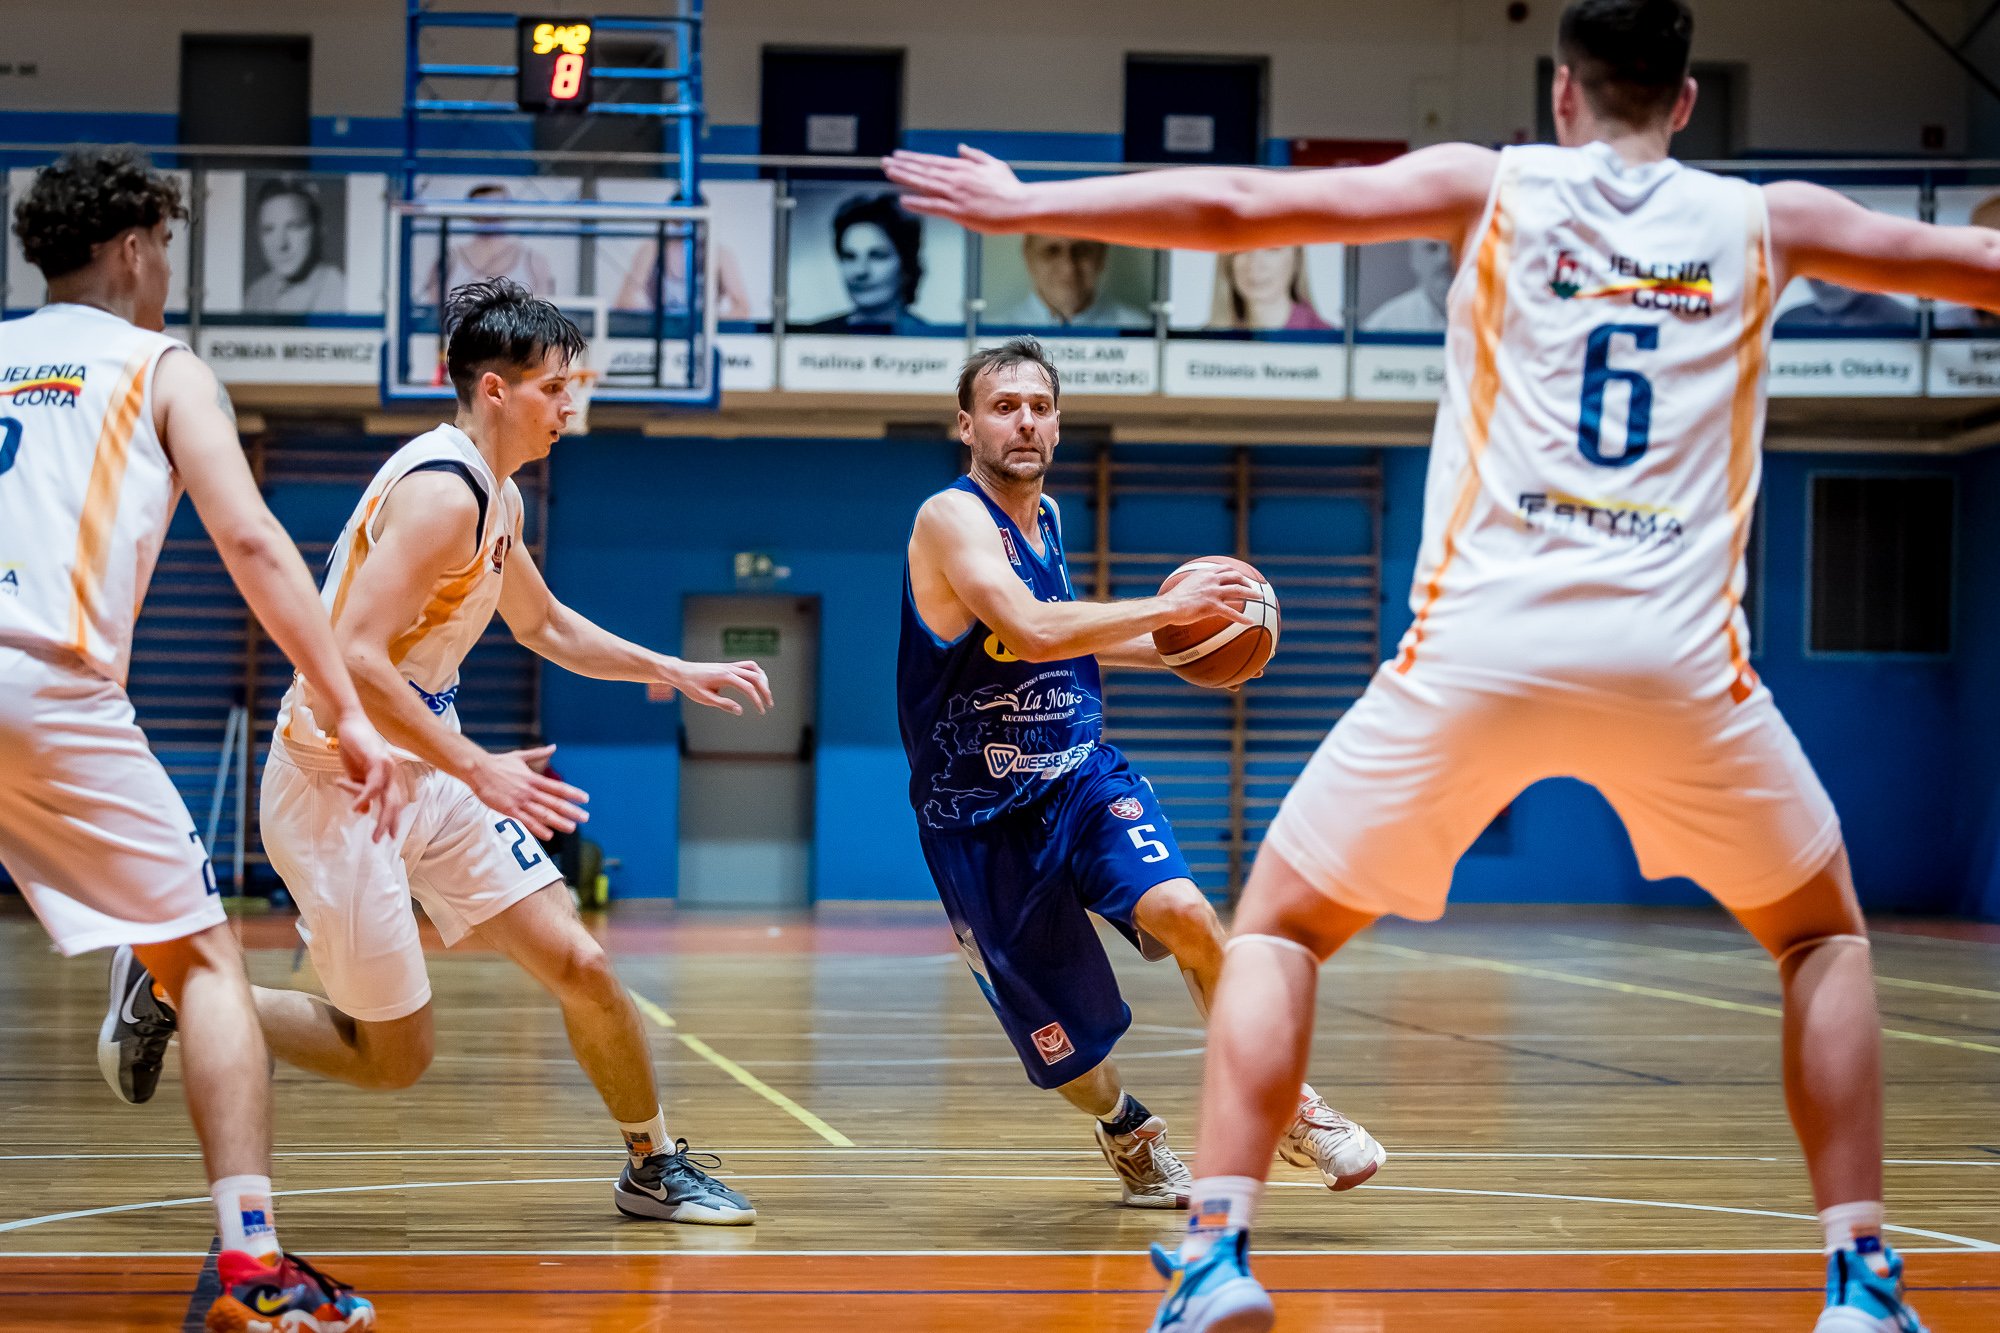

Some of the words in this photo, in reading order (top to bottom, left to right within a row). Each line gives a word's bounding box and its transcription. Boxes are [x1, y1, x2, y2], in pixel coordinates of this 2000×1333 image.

[551, 53, 584, 99] 8
[1578, 323, 1659, 467] 6
[1020, 689, 1043, 711] La
[494, 817, 550, 871] 2
[1126, 823, 1170, 863] 5
